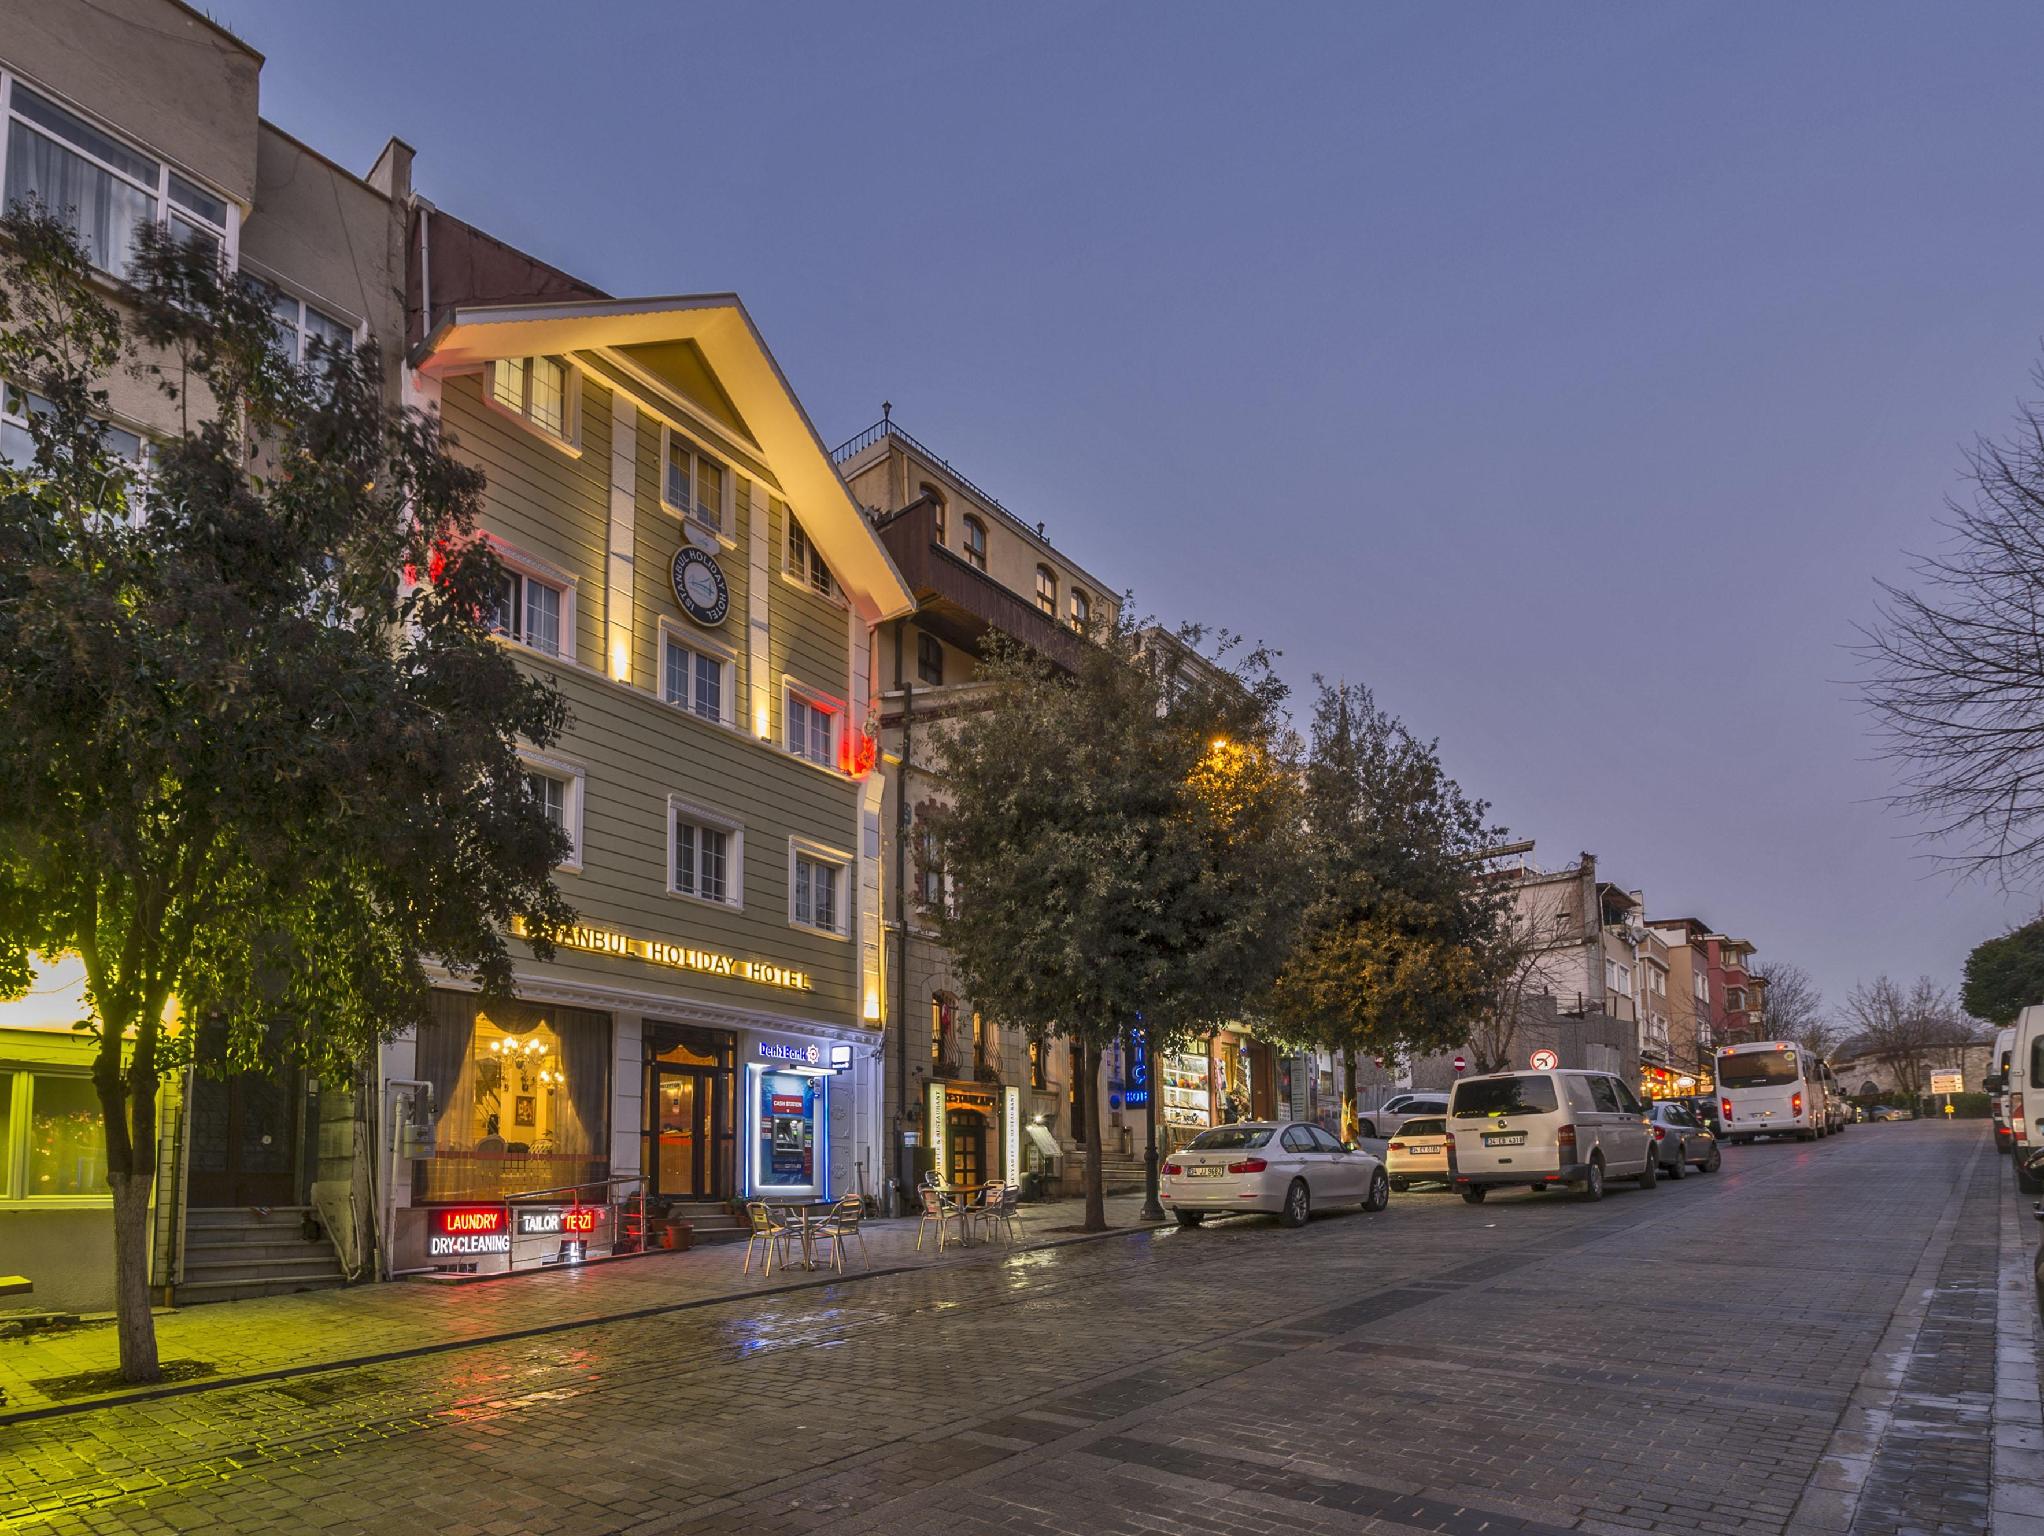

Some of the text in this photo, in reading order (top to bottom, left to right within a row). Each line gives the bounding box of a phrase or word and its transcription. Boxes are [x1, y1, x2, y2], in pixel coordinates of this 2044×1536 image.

[675, 550, 727, 621] ISTANBUL HOLIDAY HOTEL
[652, 942, 735, 975] HOLIDAY
[751, 963, 811, 990] HOTEL
[447, 1213, 498, 1231] LAUNDRY
[524, 1215, 559, 1231] TAILOR
[432, 1235, 510, 1255] DRY-CLEANING
